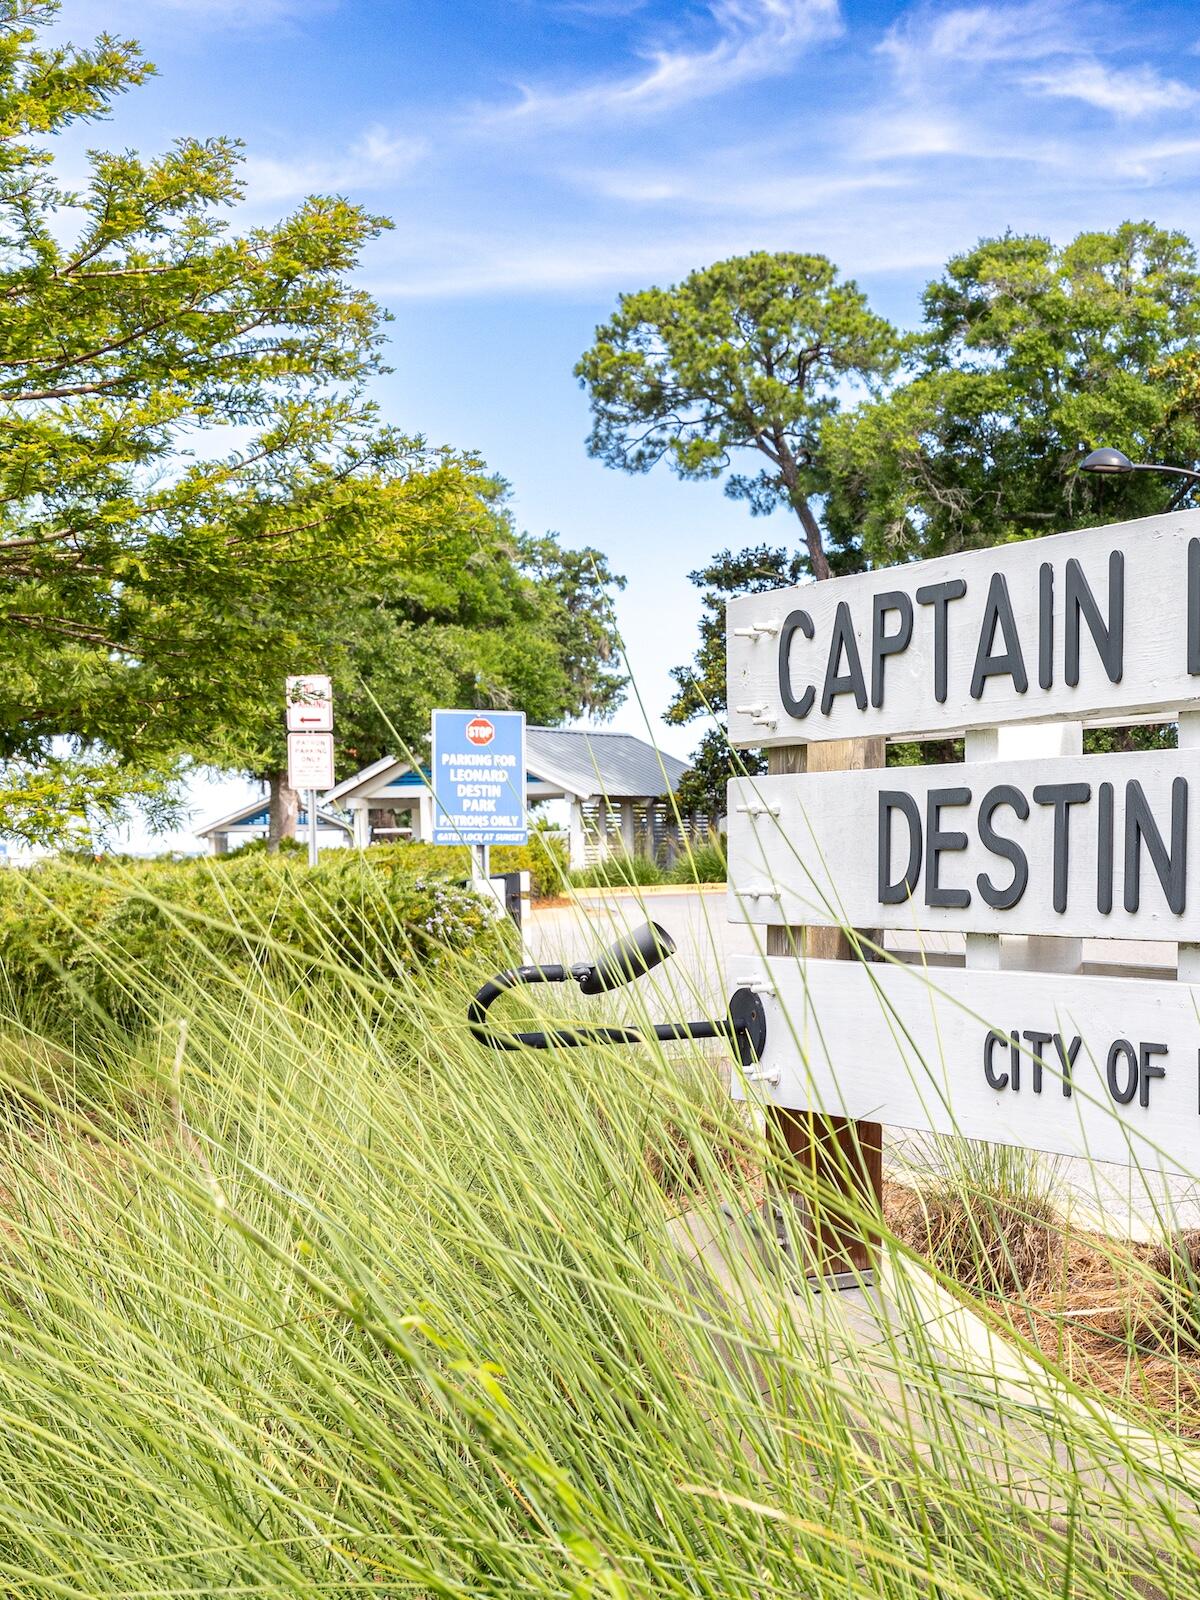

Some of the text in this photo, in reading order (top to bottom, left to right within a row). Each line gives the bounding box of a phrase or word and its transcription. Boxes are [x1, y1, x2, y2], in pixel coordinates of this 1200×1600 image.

[778, 548, 1126, 720] CAPTAIN
[467, 726, 492, 738] STOP
[441, 753, 516, 767] PARKING FOR
[450, 769, 508, 782] LEONARD
[457, 784, 501, 797] DESTIN
[462, 799, 496, 812] PARK
[439, 815, 519, 827] PATRONS ONLY
[464, 833, 483, 842] LOCK
[484, 833, 495, 841] AT
[496, 833, 526, 842] SUNSET
[877, 775, 1190, 918] DESTIN
[983, 1029, 1083, 1098] CITY
[1105, 1038, 1170, 1109] OF
